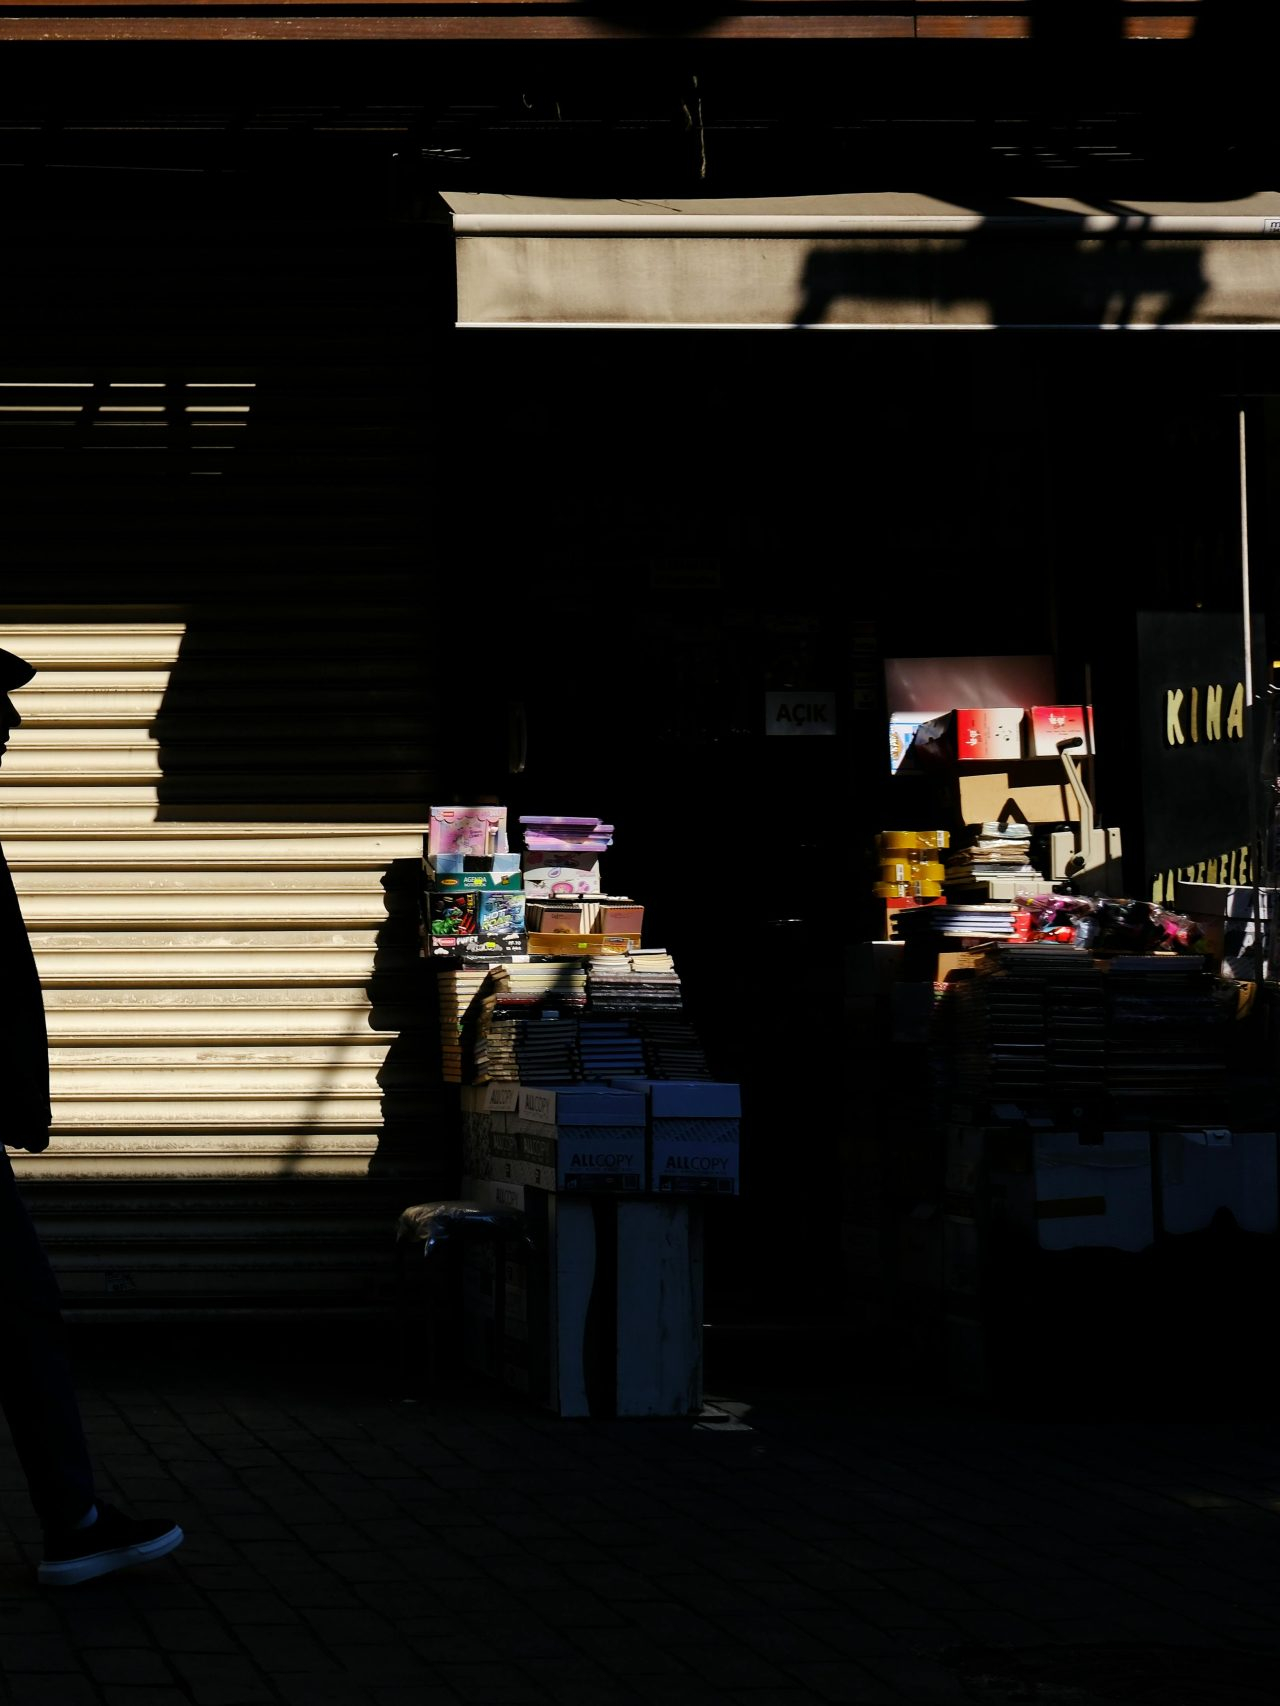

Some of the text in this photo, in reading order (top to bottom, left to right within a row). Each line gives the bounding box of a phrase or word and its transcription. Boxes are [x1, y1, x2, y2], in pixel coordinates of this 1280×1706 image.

[776, 703, 826, 726] AÇIK
[1167, 682, 1244, 746] KINA
[570, 1153, 633, 1168] ALLCOPY
[666, 1156, 729, 1171] ALLCOPY
